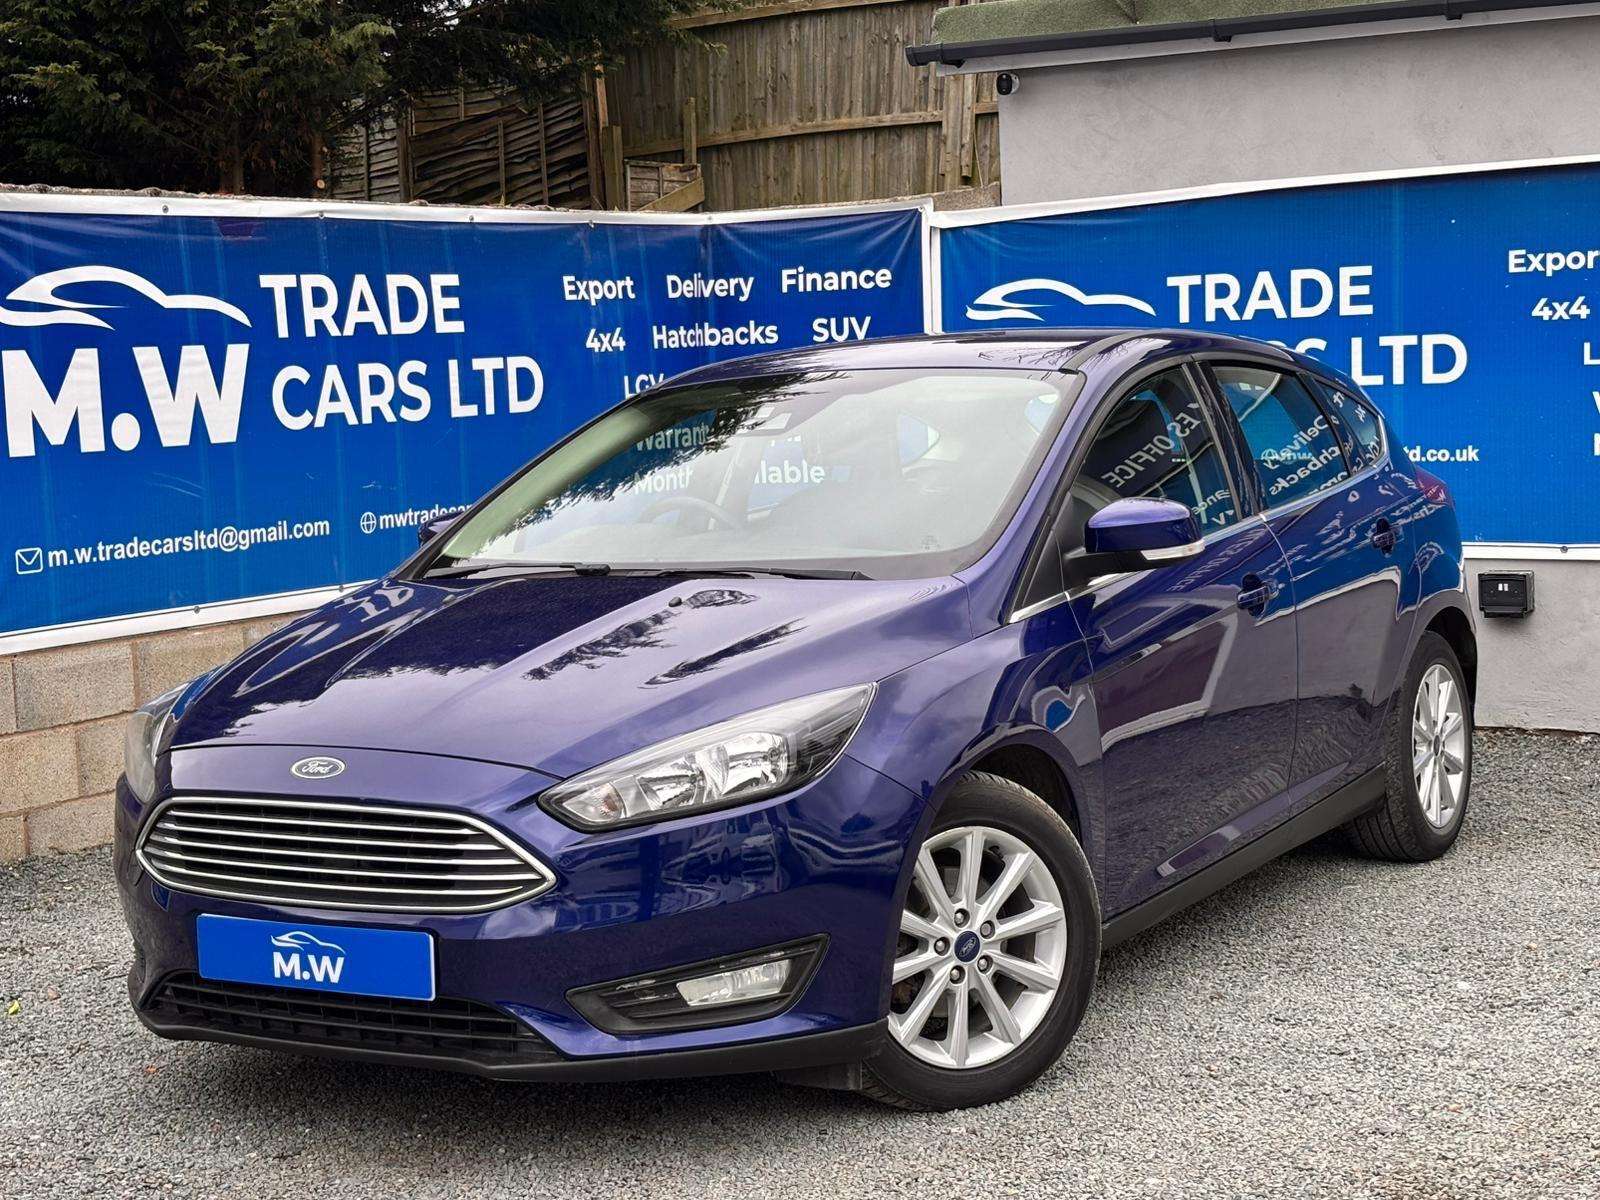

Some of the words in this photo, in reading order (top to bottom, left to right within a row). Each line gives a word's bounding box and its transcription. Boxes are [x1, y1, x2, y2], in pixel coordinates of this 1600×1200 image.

[1508, 249, 1600, 276] Expor
[258, 273, 465, 339] TRADE
[562, 275, 636, 306] Export
[666, 272, 755, 302] Delivery
[781, 265, 893, 294] Finance
[1166, 265, 1374, 324] TRADE
[1531, 296, 1591, 321] 4x4
[585, 327, 626, 353] 4x4
[652, 320, 779, 349] Hatchbacks
[812, 316, 873, 343] SUV
[1351, 333, 1468, 386] LTD
[1, 343, 250, 458] M.W
[272, 359, 431, 430] CARS
[448, 355, 544, 418] LTD
[636, 422, 712, 451] Warrant
[48, 519, 330, 567] m.w.tradecarsltd@gmail.com
[273, 951, 345, 983] M.W
